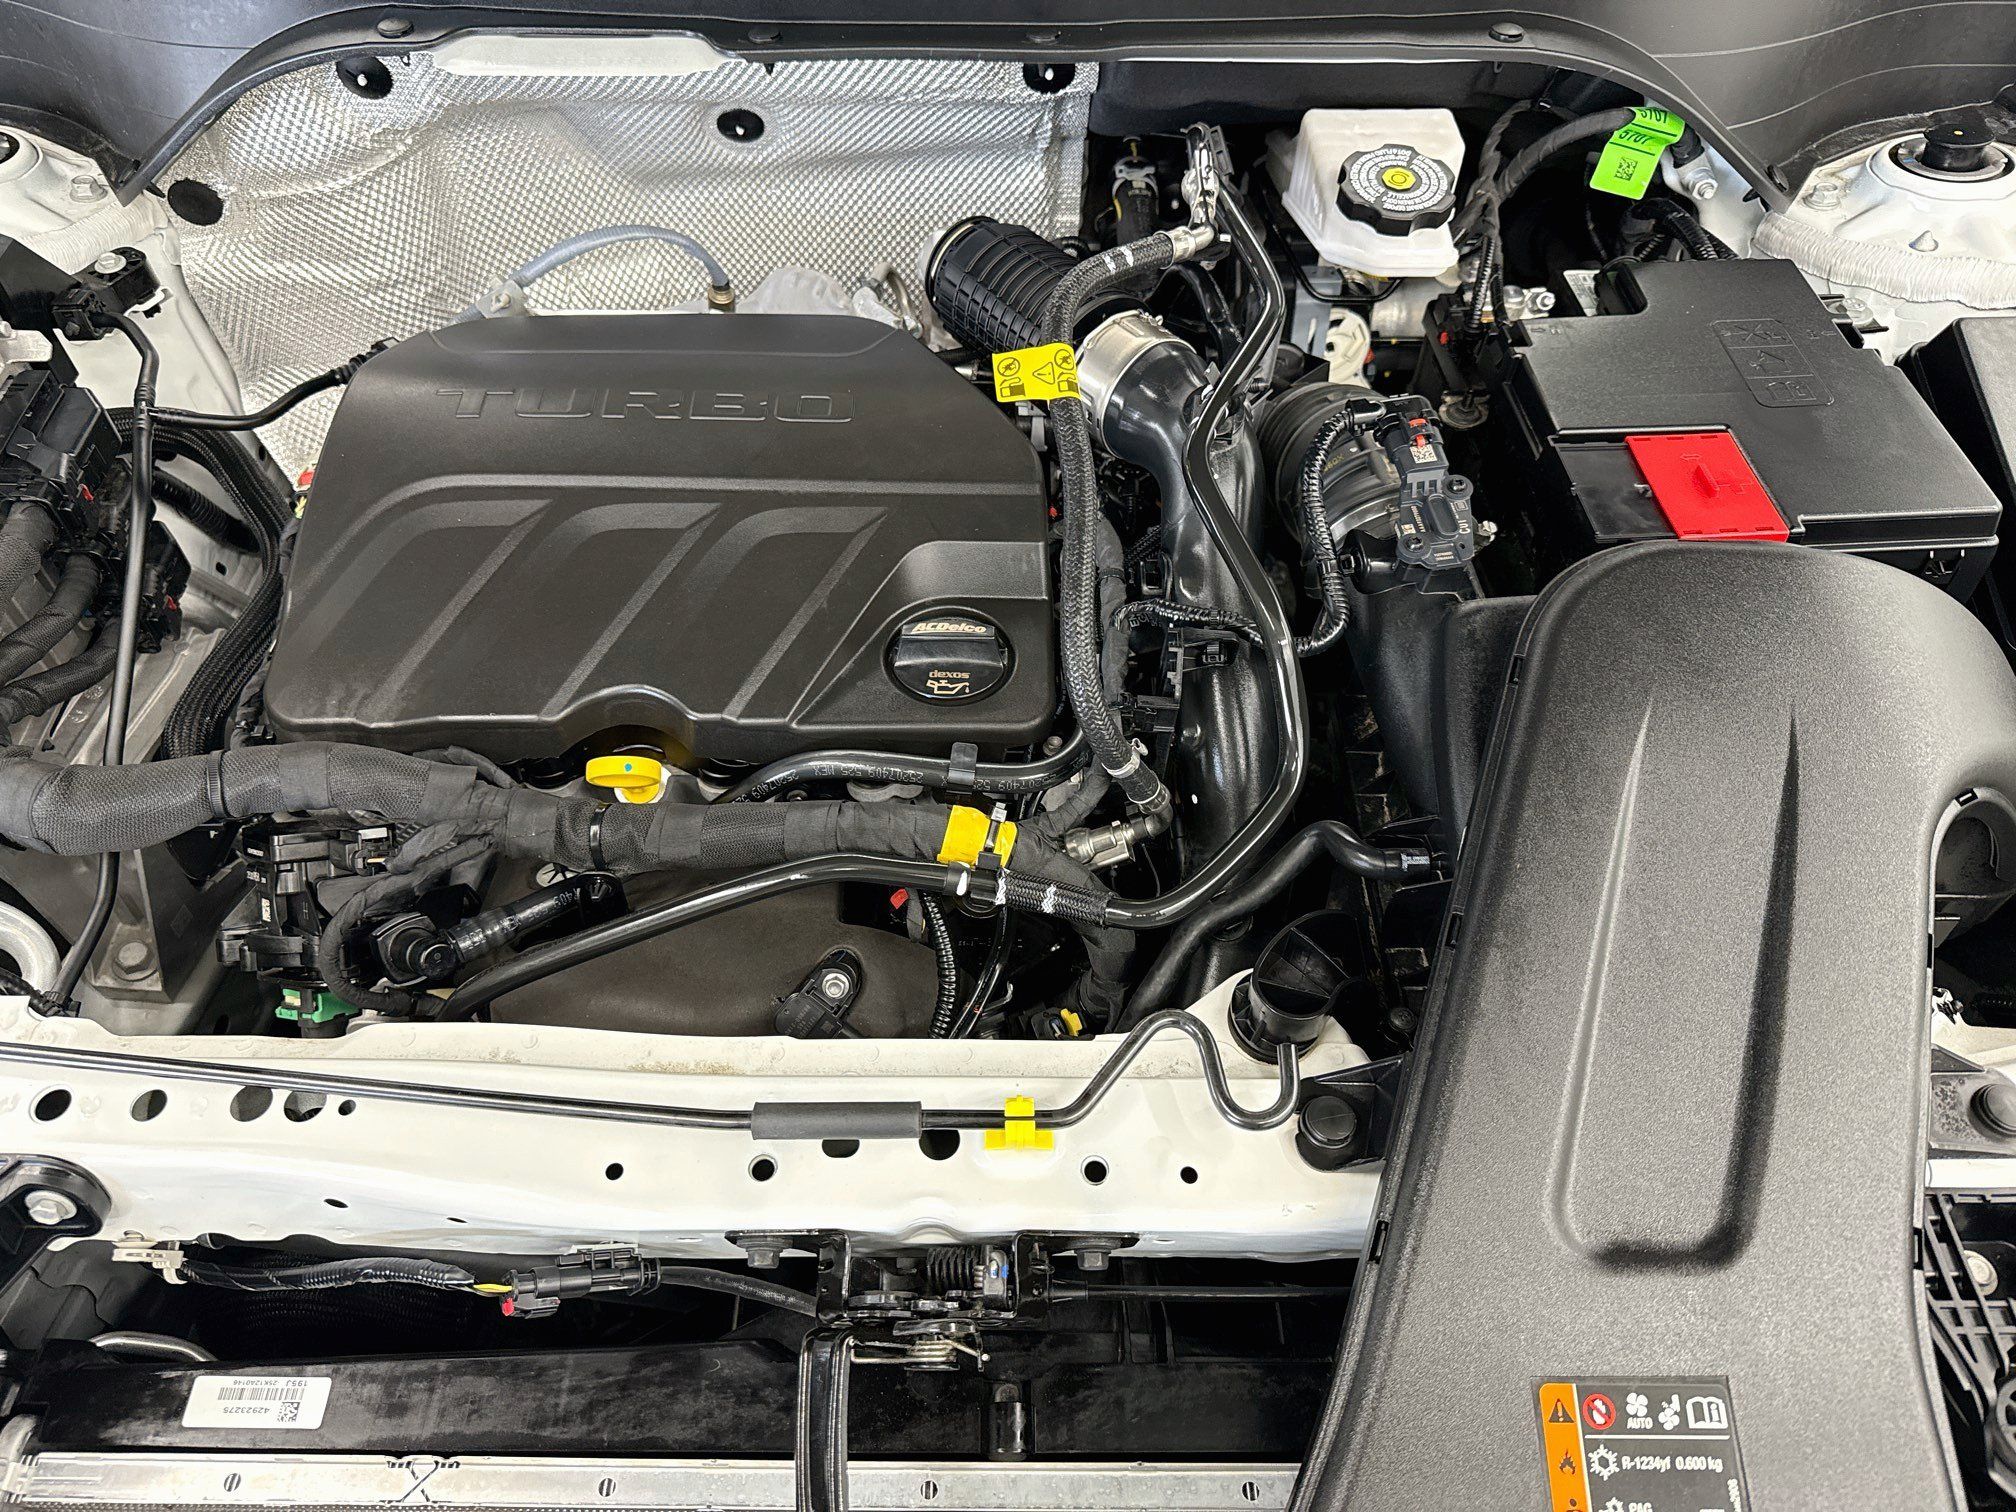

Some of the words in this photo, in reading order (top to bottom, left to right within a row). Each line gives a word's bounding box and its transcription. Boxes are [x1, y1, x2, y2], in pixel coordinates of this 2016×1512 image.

[1619, 129, 1653, 144] 5707
[437, 387, 856, 424] TURBO
[911, 622, 987, 634] ACDelco
[928, 670, 971, 679] dexos
[814, 765, 836, 776] MEX
[841, 767, 862, 777] 525
[867, 766, 924, 784] 25207409
[222, 1406, 270, 1414] 42923275
[1626, 1417, 1653, 1430] AUTO
[1621, 1455, 1671, 1473] R-1234yf
[1675, 1455, 1707, 1471] 0.600
[1708, 1456, 1724, 1473] kg
